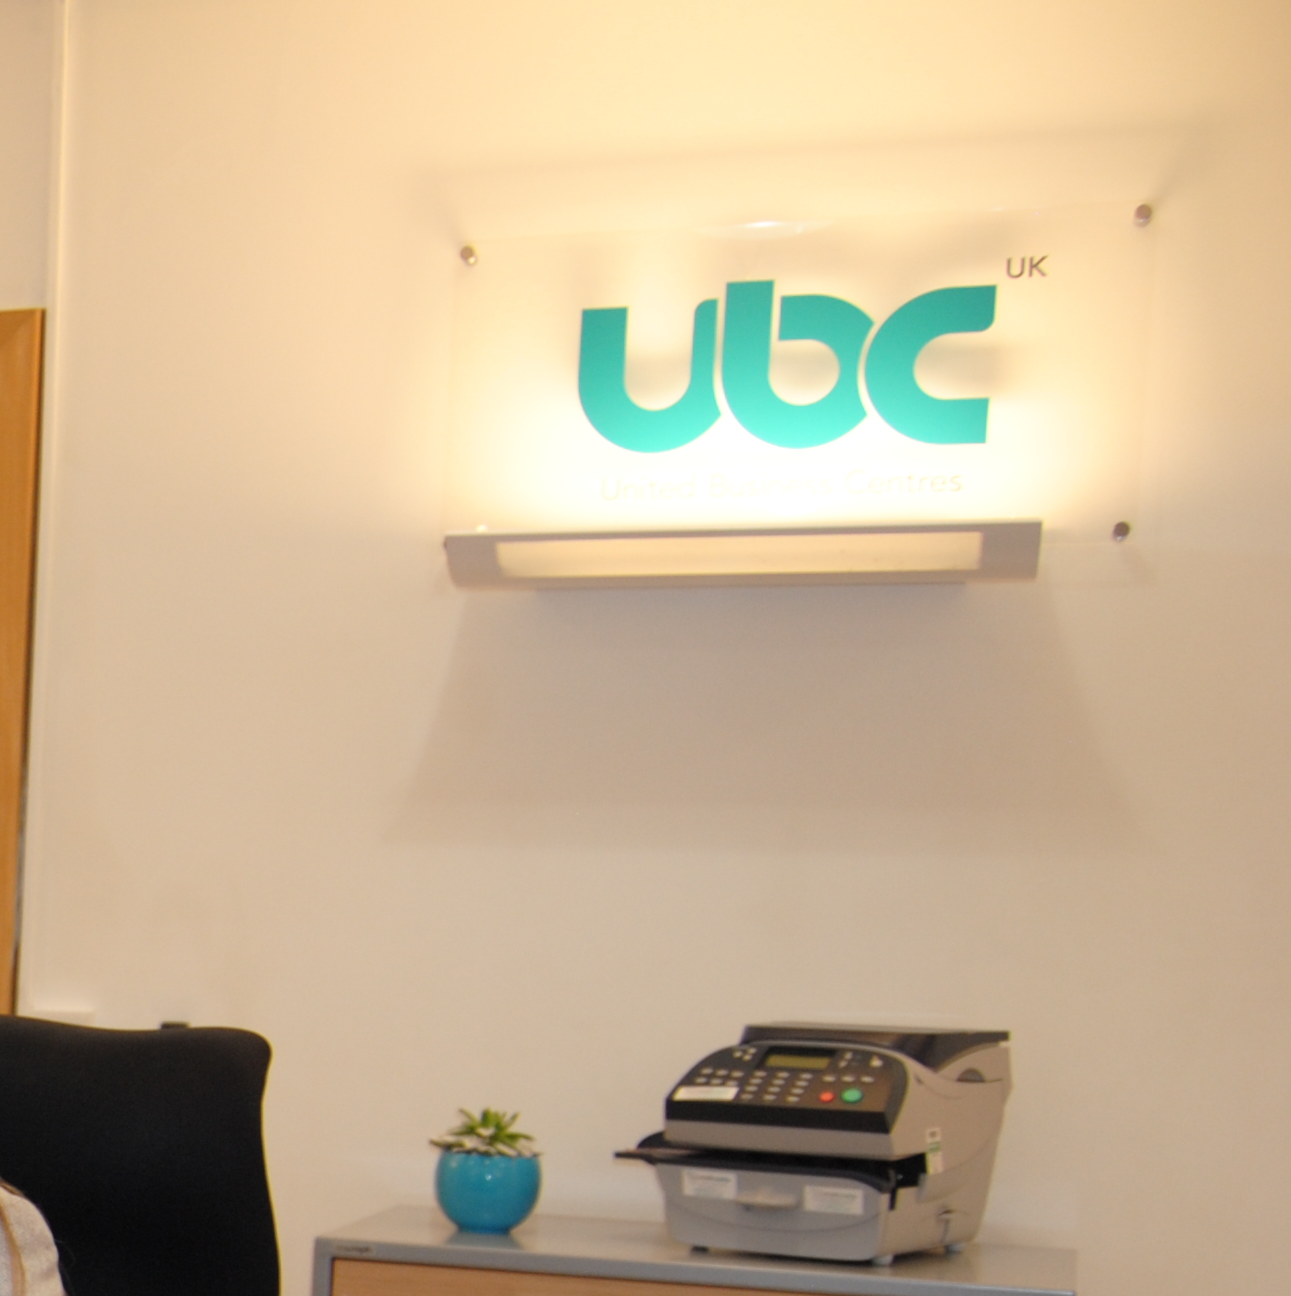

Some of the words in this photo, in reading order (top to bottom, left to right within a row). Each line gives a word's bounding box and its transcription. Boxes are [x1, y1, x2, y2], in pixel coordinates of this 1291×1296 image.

[1006, 255, 1049, 279] UK
[578, 279, 997, 453] ubc
[600, 473, 696, 501] United
[709, 472, 832, 498] Business
[844, 469, 962, 496] Centres
